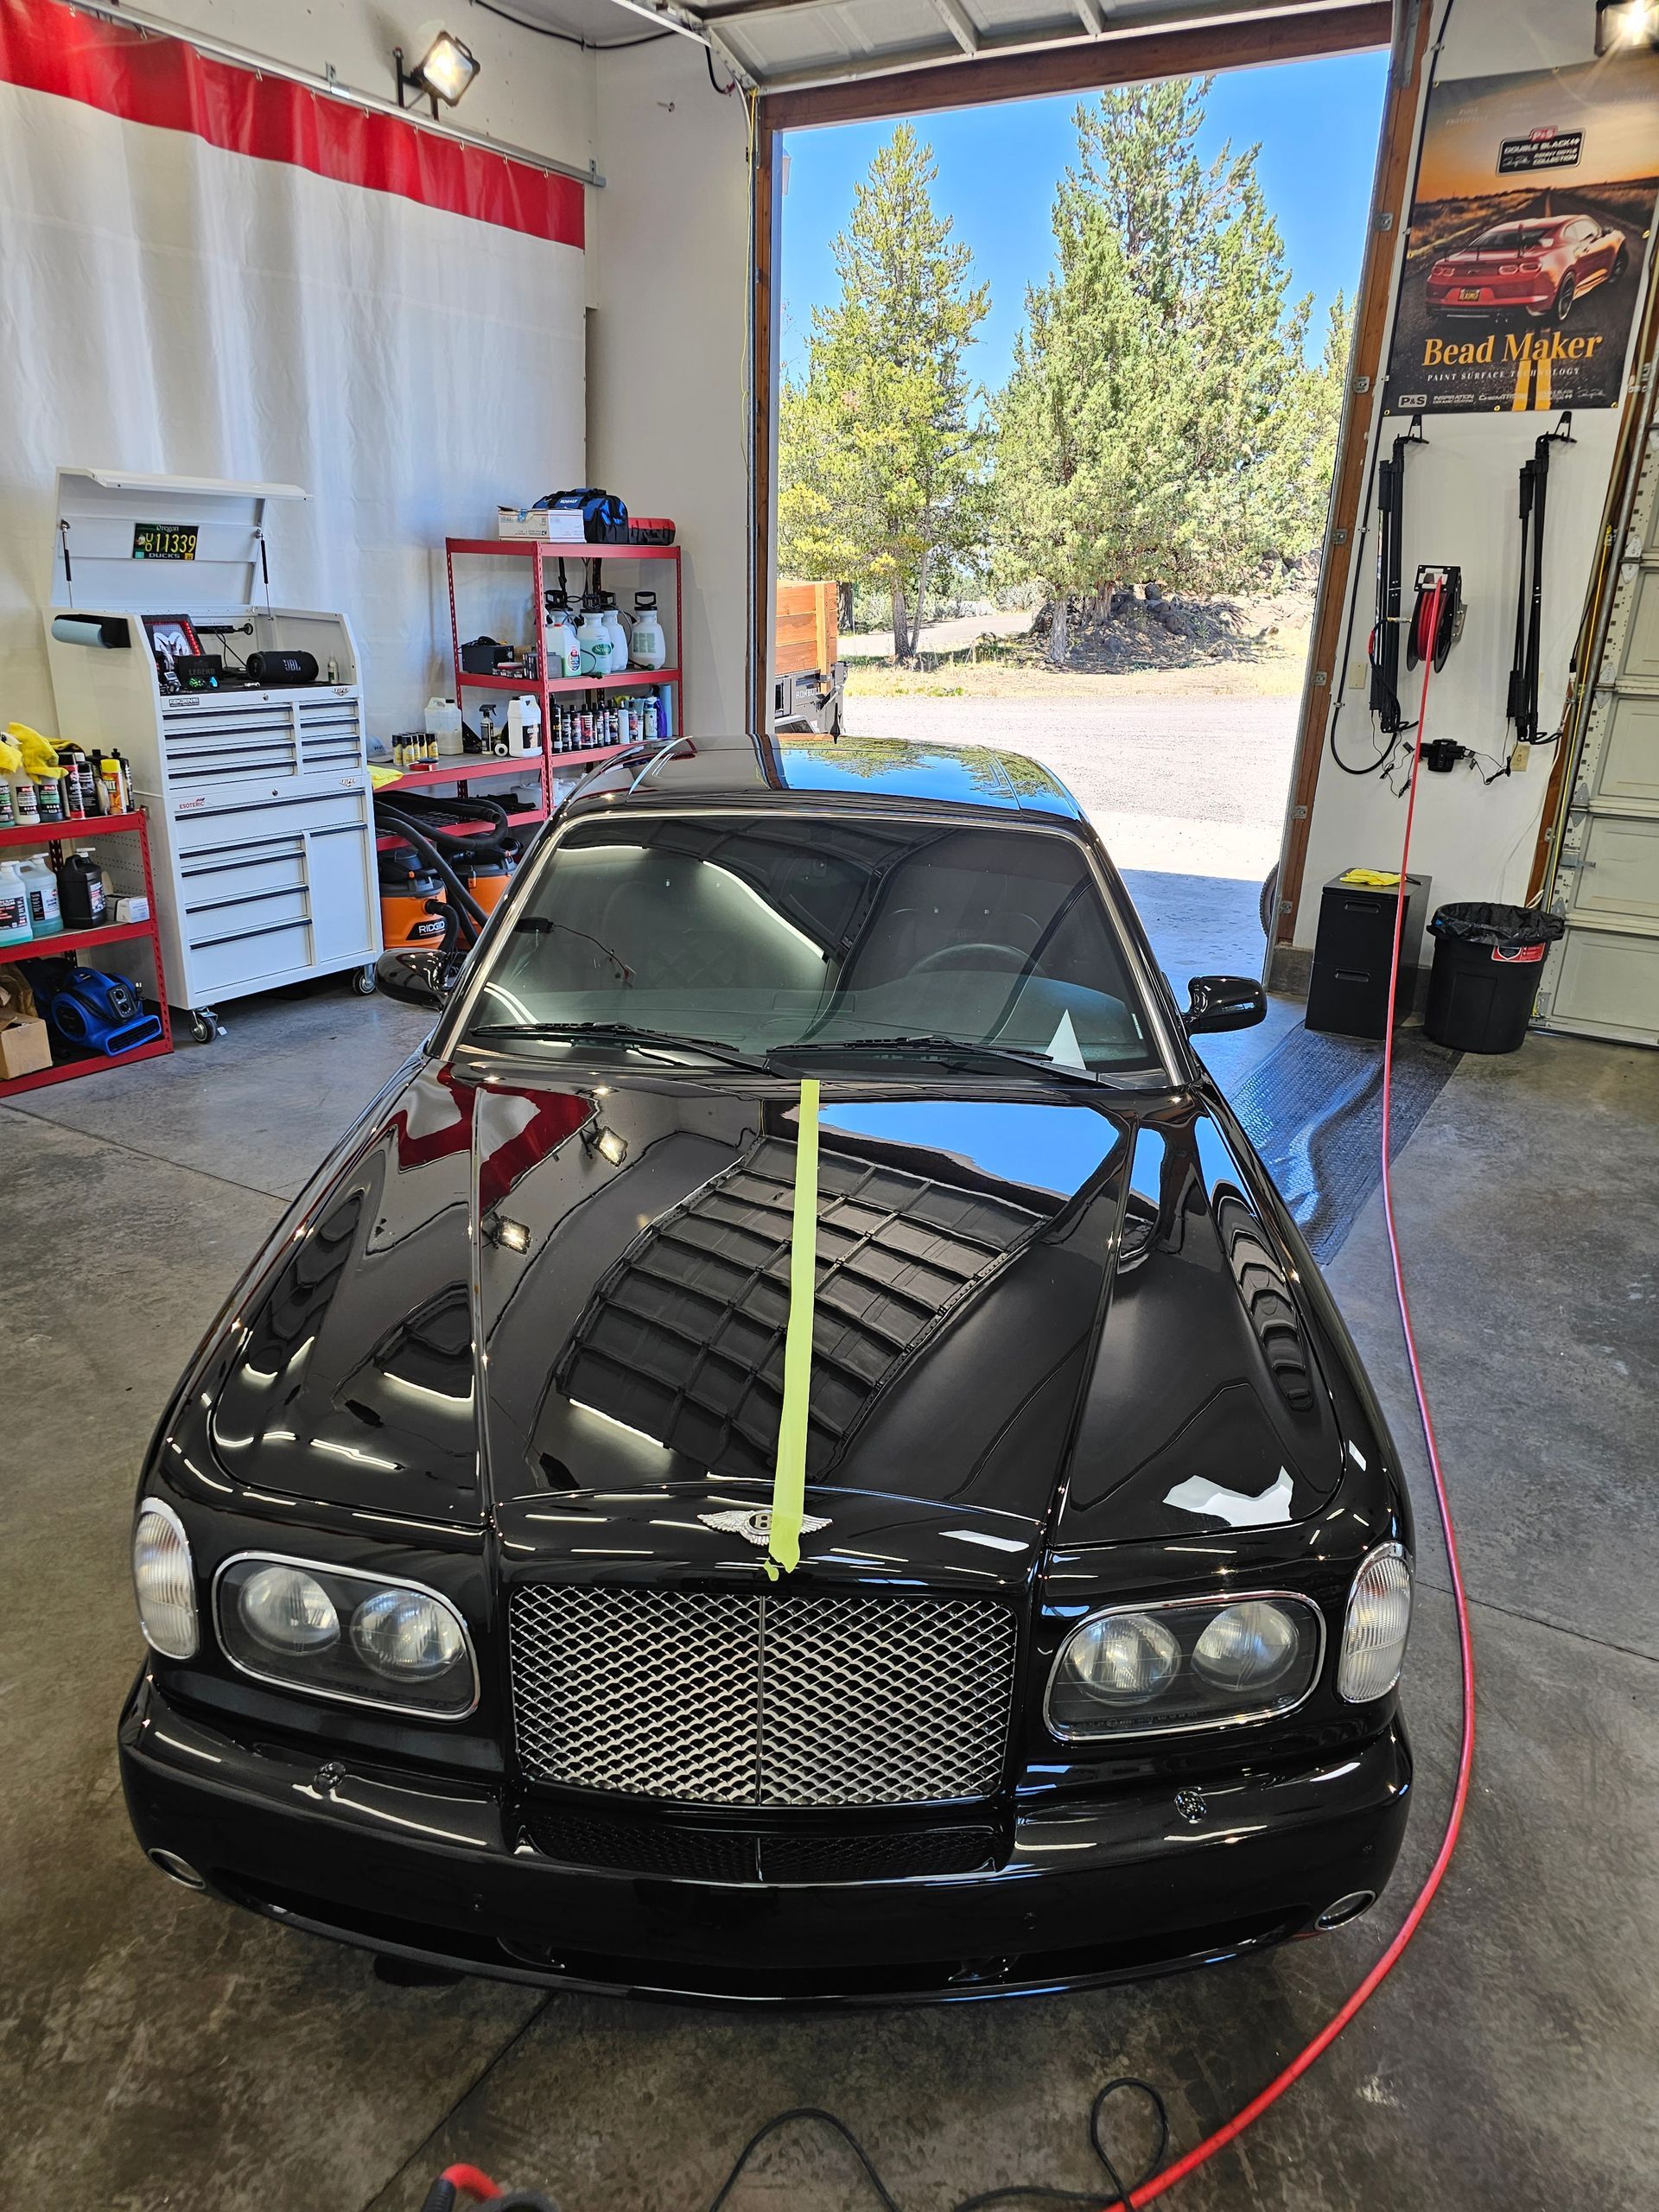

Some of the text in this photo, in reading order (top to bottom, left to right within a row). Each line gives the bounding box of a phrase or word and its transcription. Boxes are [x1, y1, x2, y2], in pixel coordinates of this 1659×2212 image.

[1504, 143, 1540, 154] DOUBLE
[1533, 154, 1578, 166] COLLECTION
[1421, 331, 1604, 366] Bead Maker
[1427, 372, 1458, 382] PAINT
[1461, 371, 1506, 381] SURFACE
[1400, 396, 1426, 406] P&S
[283, 659, 302, 671] JBL
